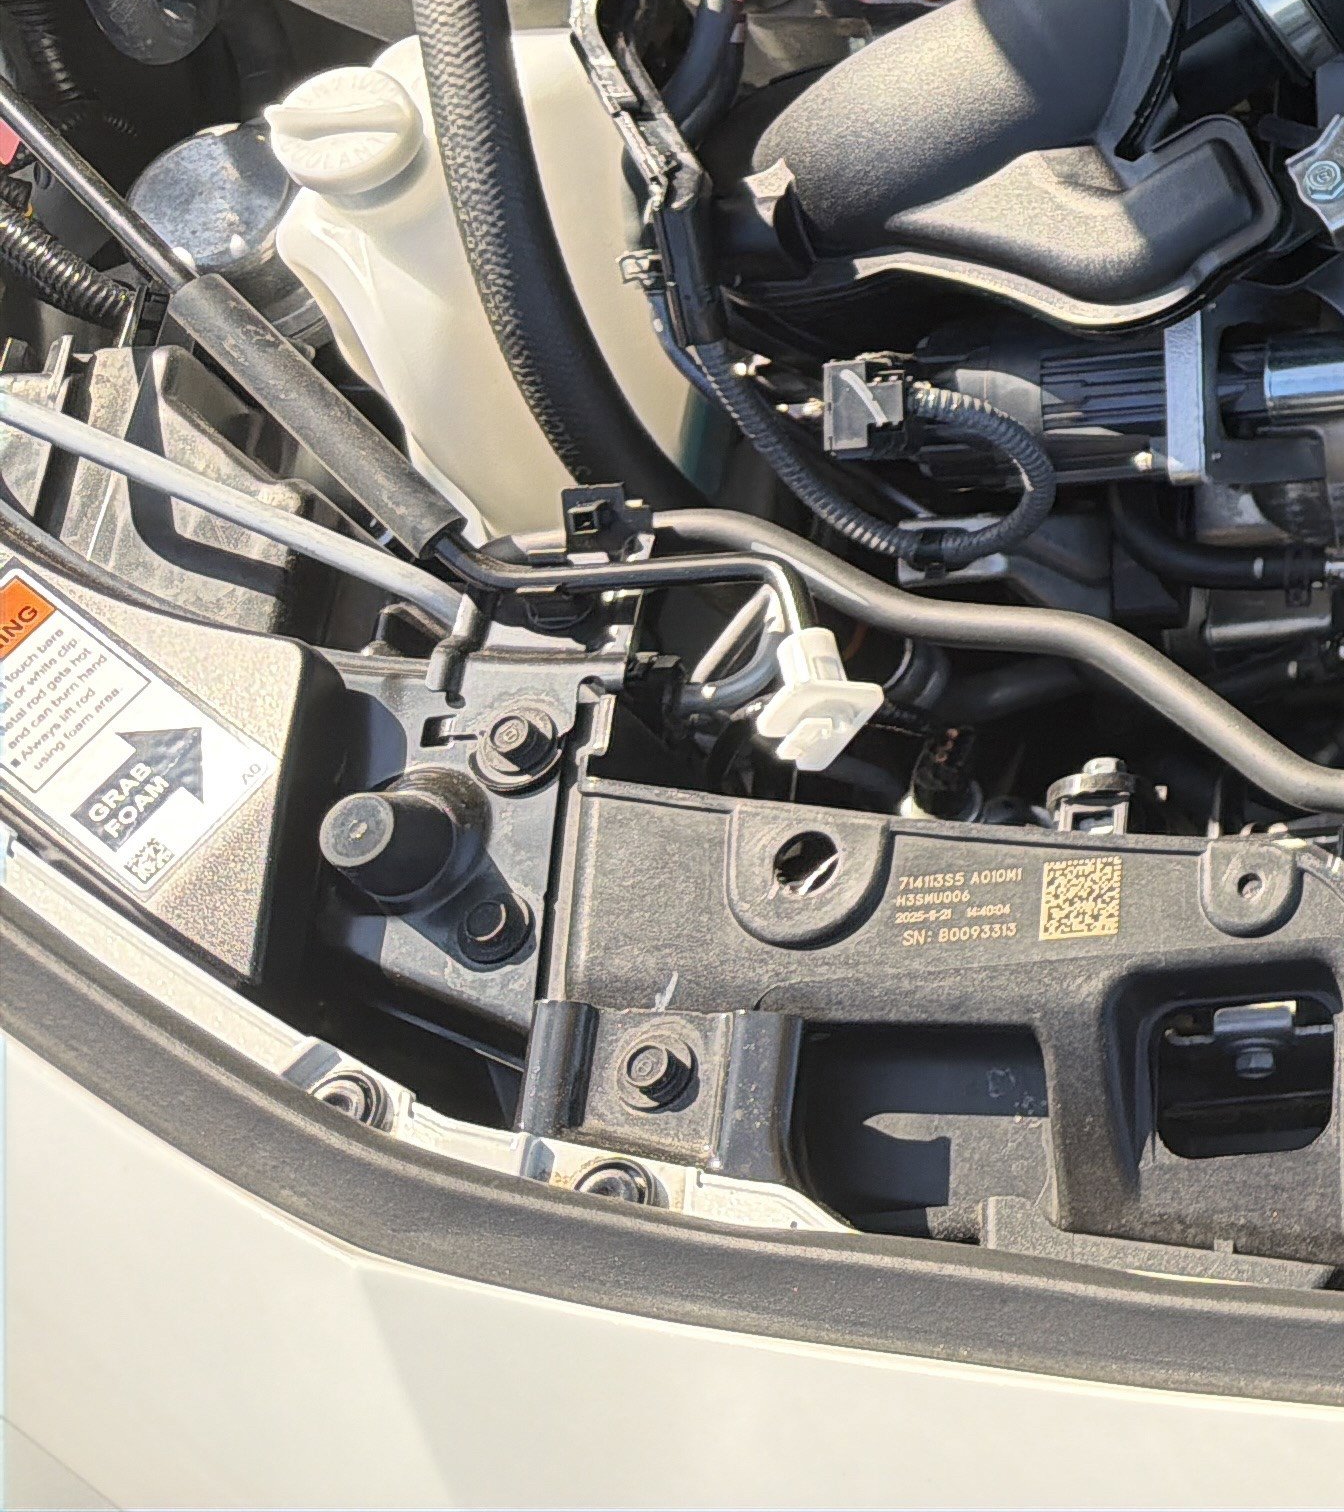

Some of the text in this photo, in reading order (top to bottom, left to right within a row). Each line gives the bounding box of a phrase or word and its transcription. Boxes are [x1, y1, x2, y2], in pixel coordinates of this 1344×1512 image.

[5, 653, 38, 683] touch
[14, 685, 26, 699] or
[27, 658, 57, 685] white
[27, 688, 47, 709] rod
[47, 667, 71, 692] gets
[70, 648, 93, 667] hot
[8, 653, 108, 749] and can burn hand
[21, 687, 96, 761] Always lift rod
[34, 741, 66, 770] using
[63, 713, 94, 740] foam
[88, 762, 151, 822] GRAB
[103, 775, 170, 839] FOAM
[899, 872, 965, 890] 714113S5
[902, 929, 933, 947] SN:
